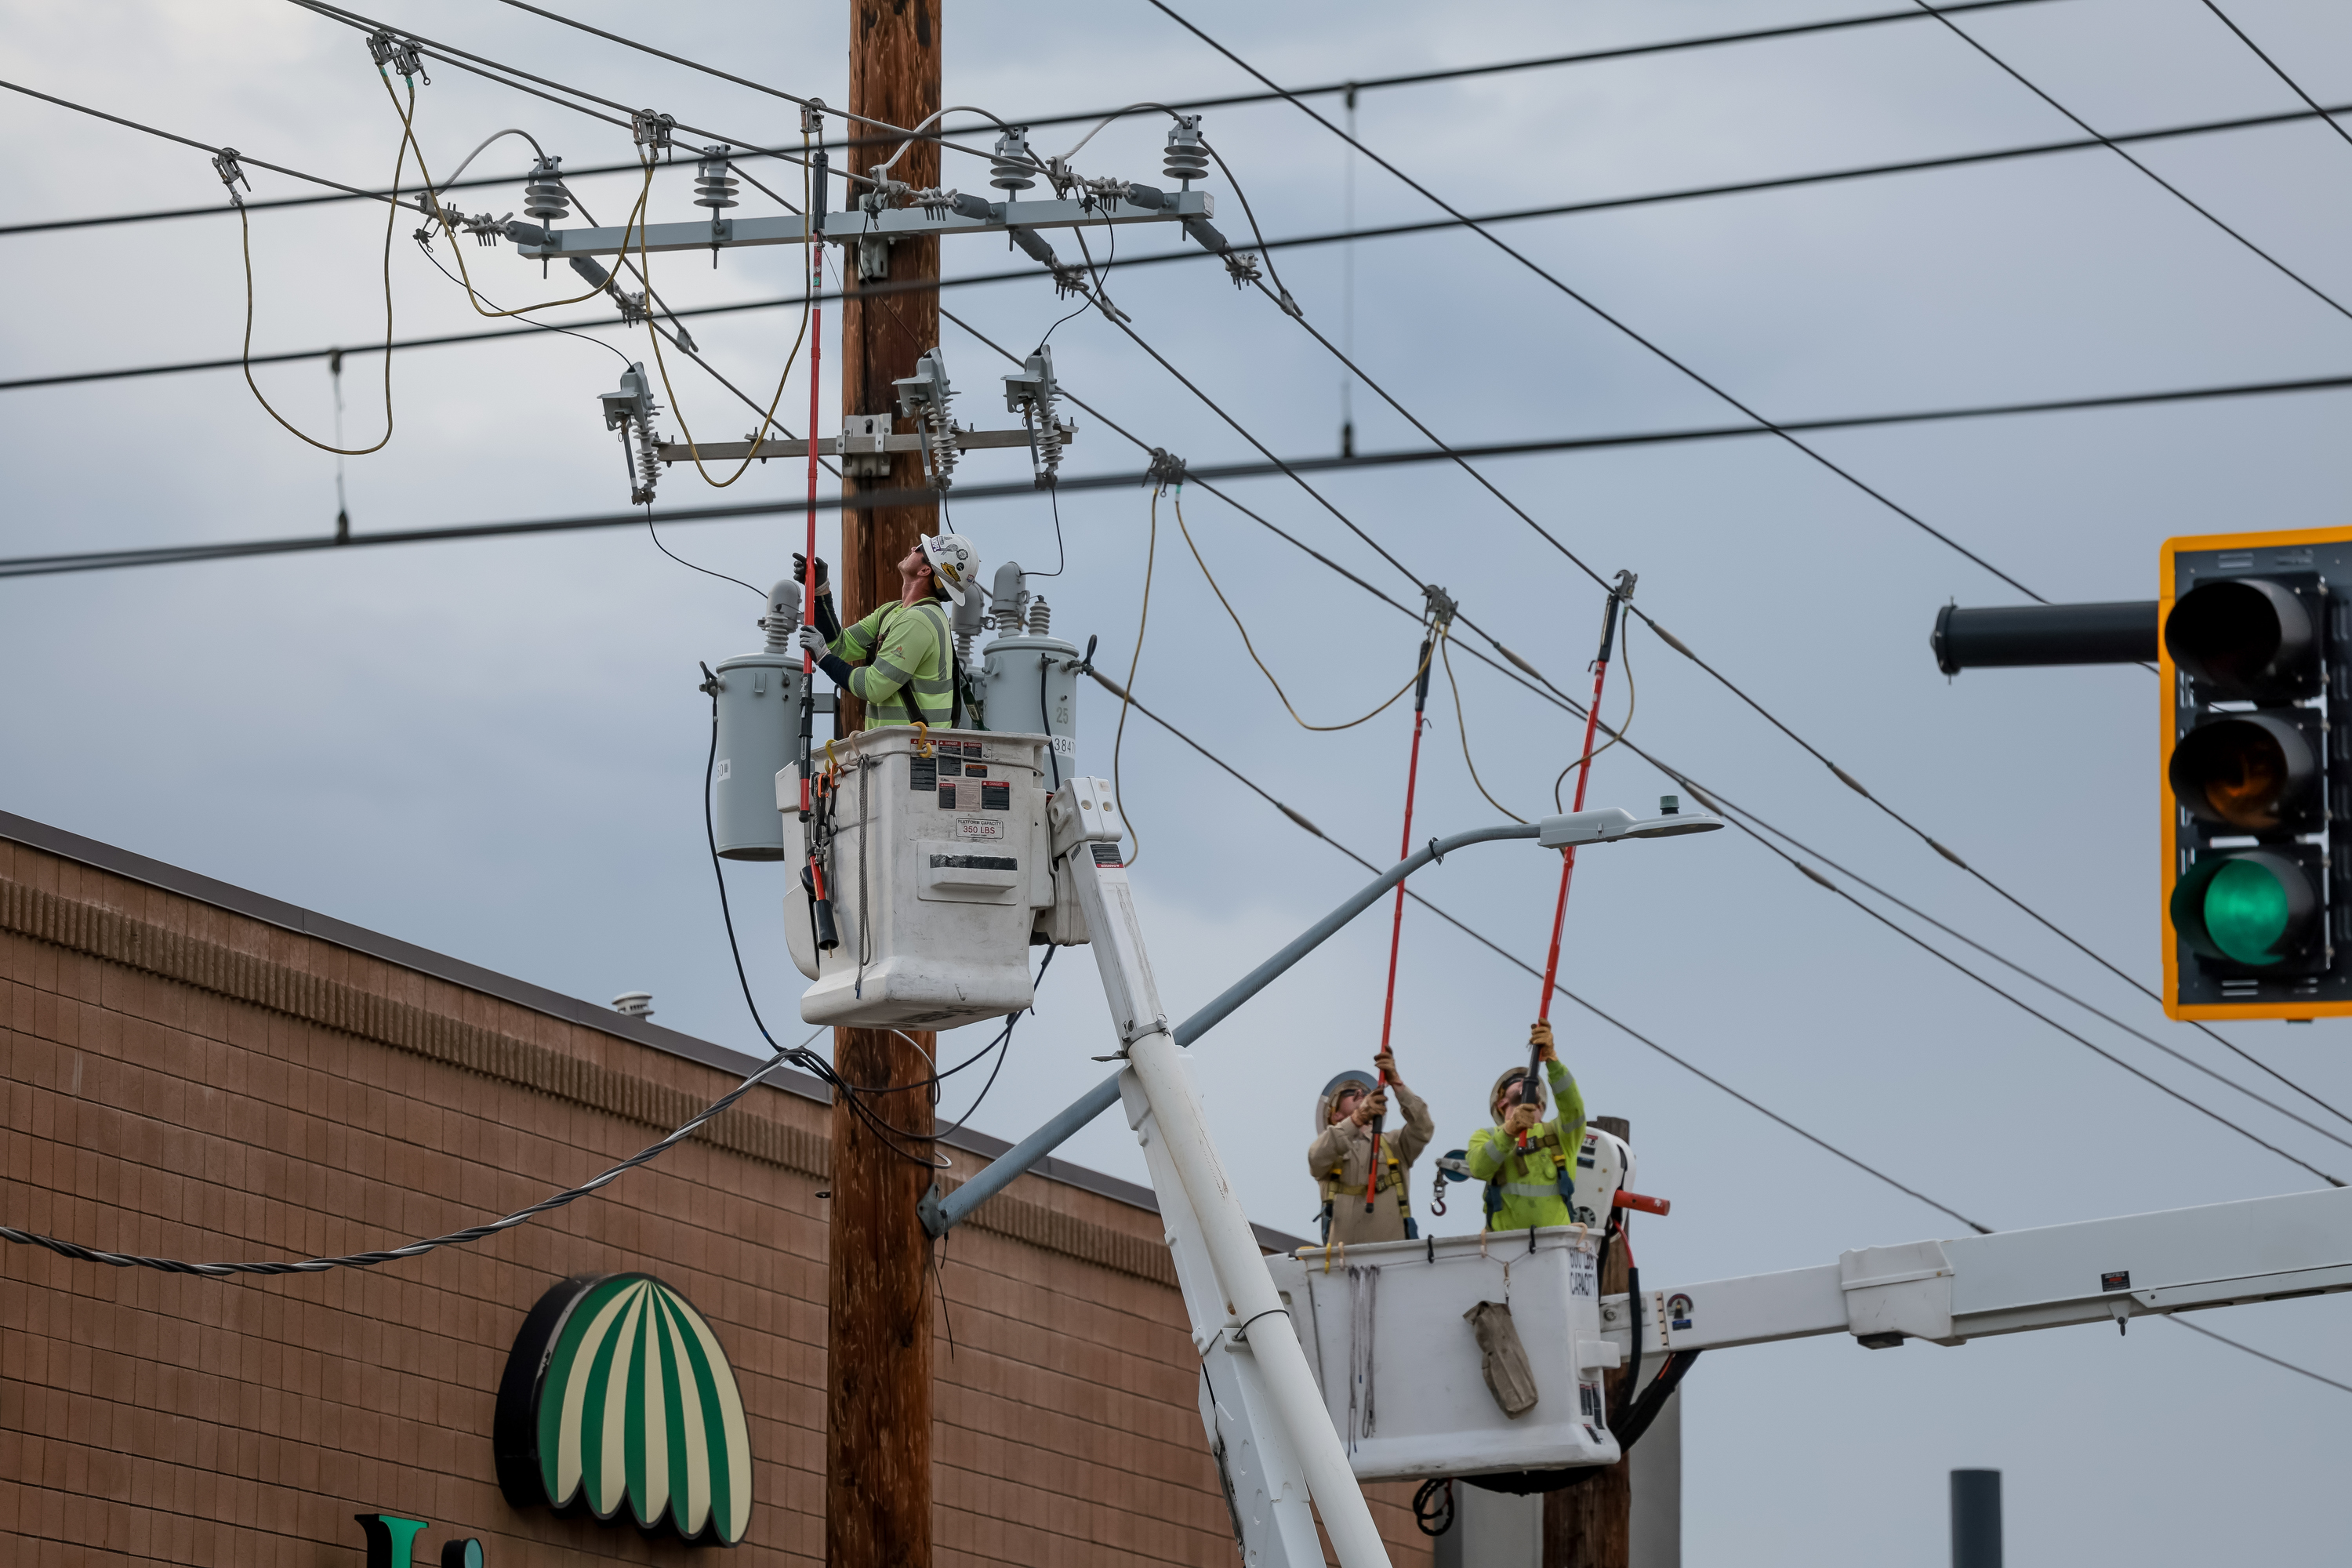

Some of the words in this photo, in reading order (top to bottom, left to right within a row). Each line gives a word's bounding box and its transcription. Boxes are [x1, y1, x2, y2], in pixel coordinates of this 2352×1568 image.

[1056, 706, 1069, 724] 25
[963, 825, 978, 833] 350
[1570, 1272, 1596, 1297] CAPACITY
